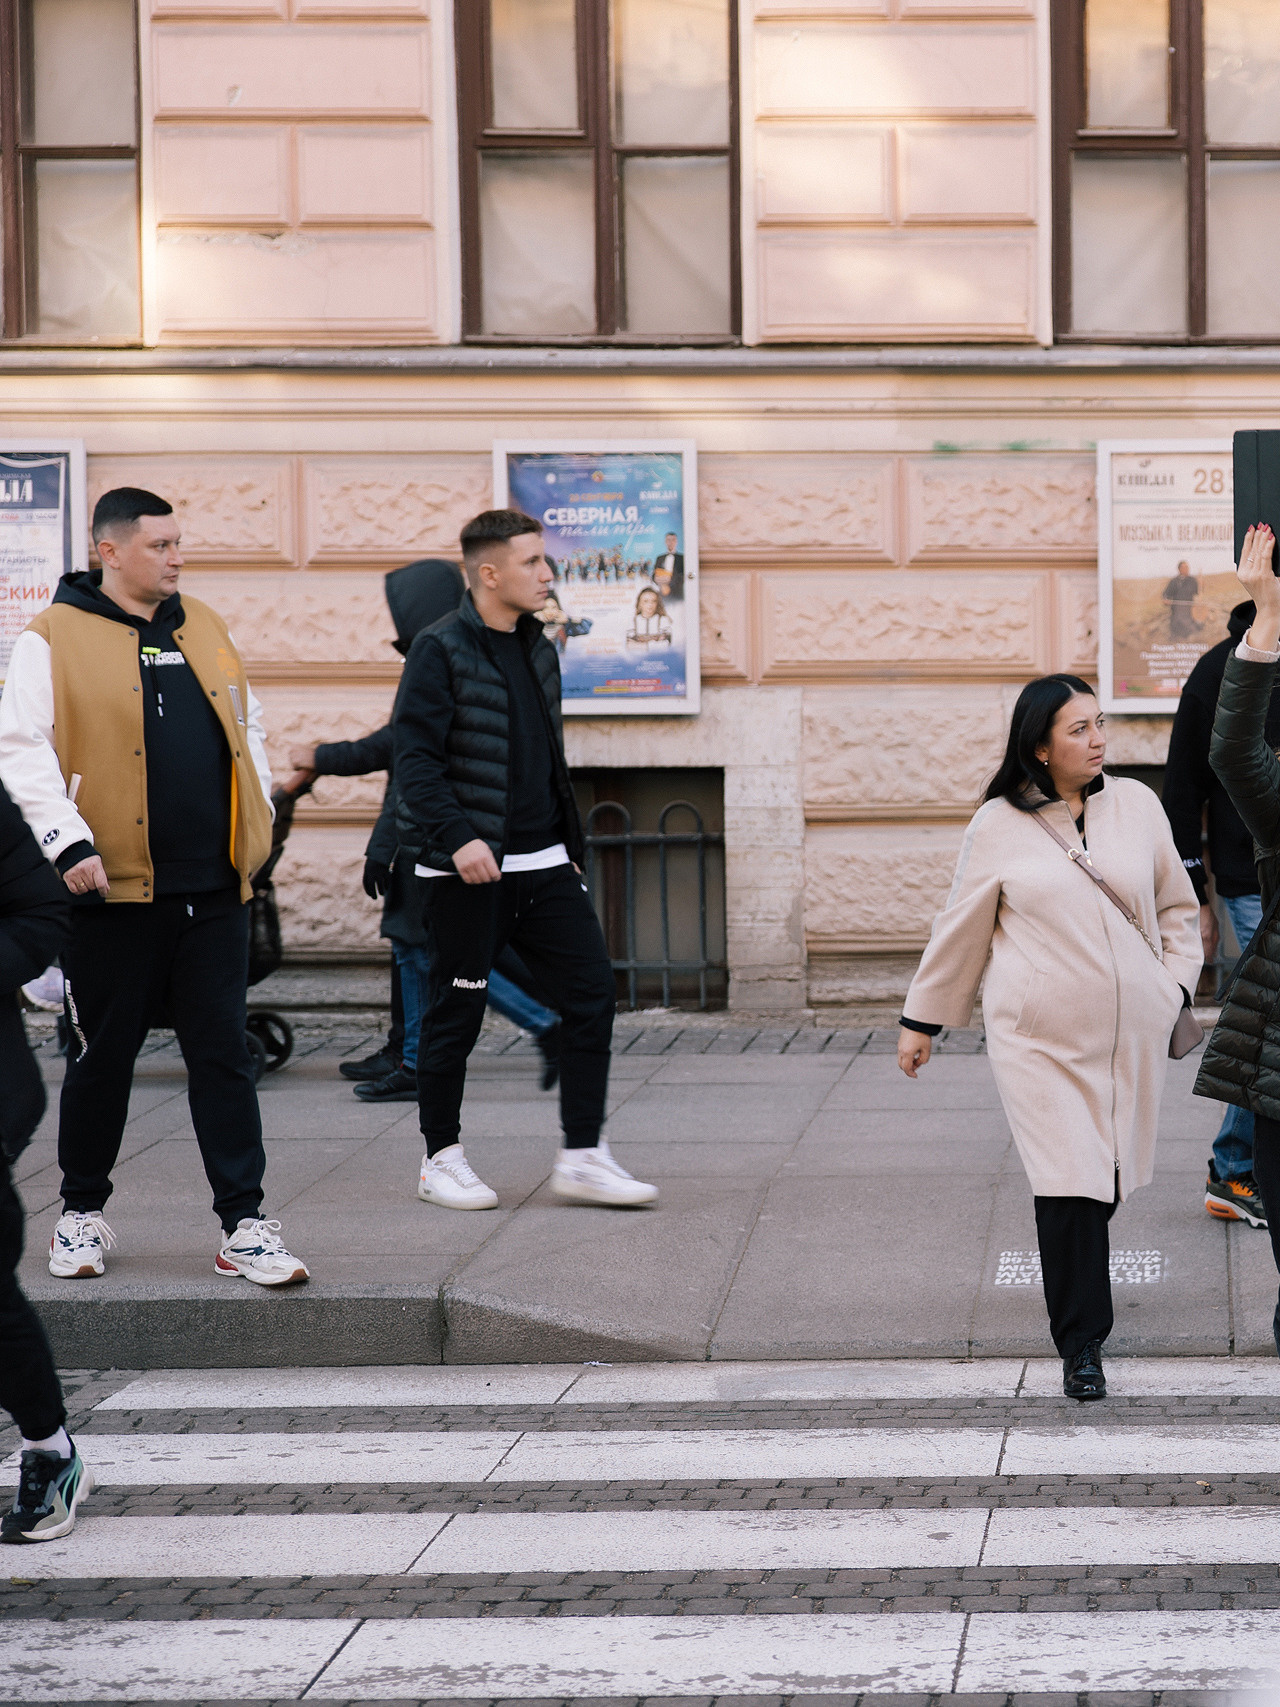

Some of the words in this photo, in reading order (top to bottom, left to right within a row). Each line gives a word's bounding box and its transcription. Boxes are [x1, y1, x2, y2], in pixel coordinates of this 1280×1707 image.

[1193, 468, 1225, 494] 28
[543, 506, 639, 526] СЕВЕРНАЯ
[1119, 524, 1173, 542] МУЗЫКА
